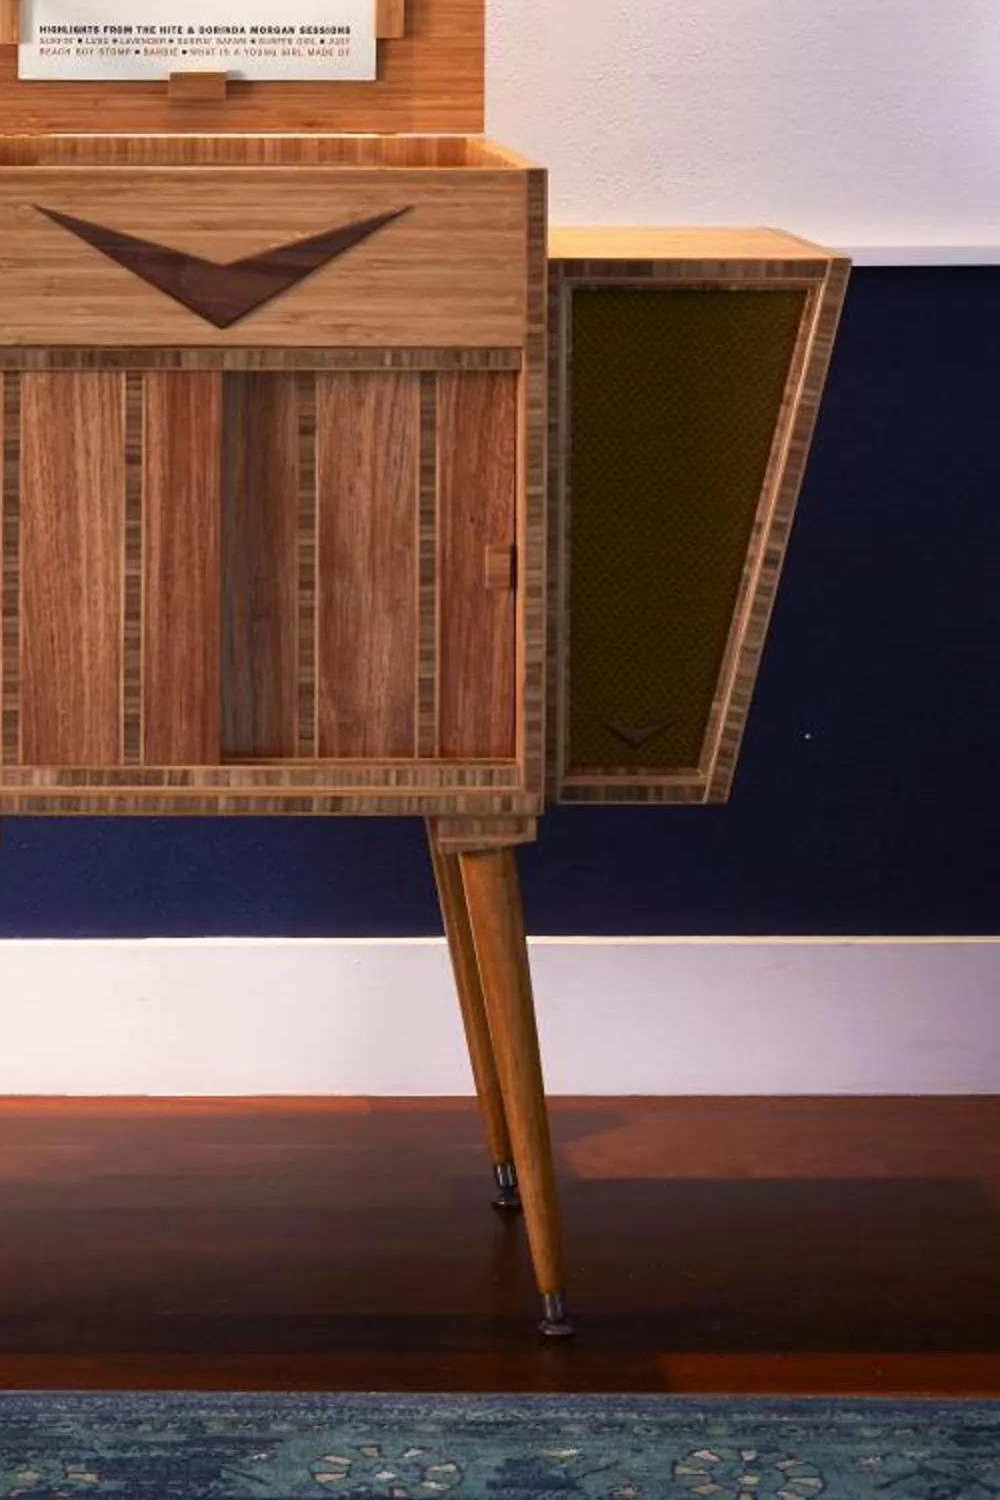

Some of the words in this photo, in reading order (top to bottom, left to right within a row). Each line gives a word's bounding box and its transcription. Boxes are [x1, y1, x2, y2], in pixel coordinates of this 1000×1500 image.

[39, 25, 100, 35] HIGHLIGHTS
[104, 25, 133, 35] FROM
[137, 25, 156, 35] THE
[160, 25, 183, 35] HITE
[250, 25, 295, 35] MORGAN
[300, 25, 351, 35] SESSIONS
